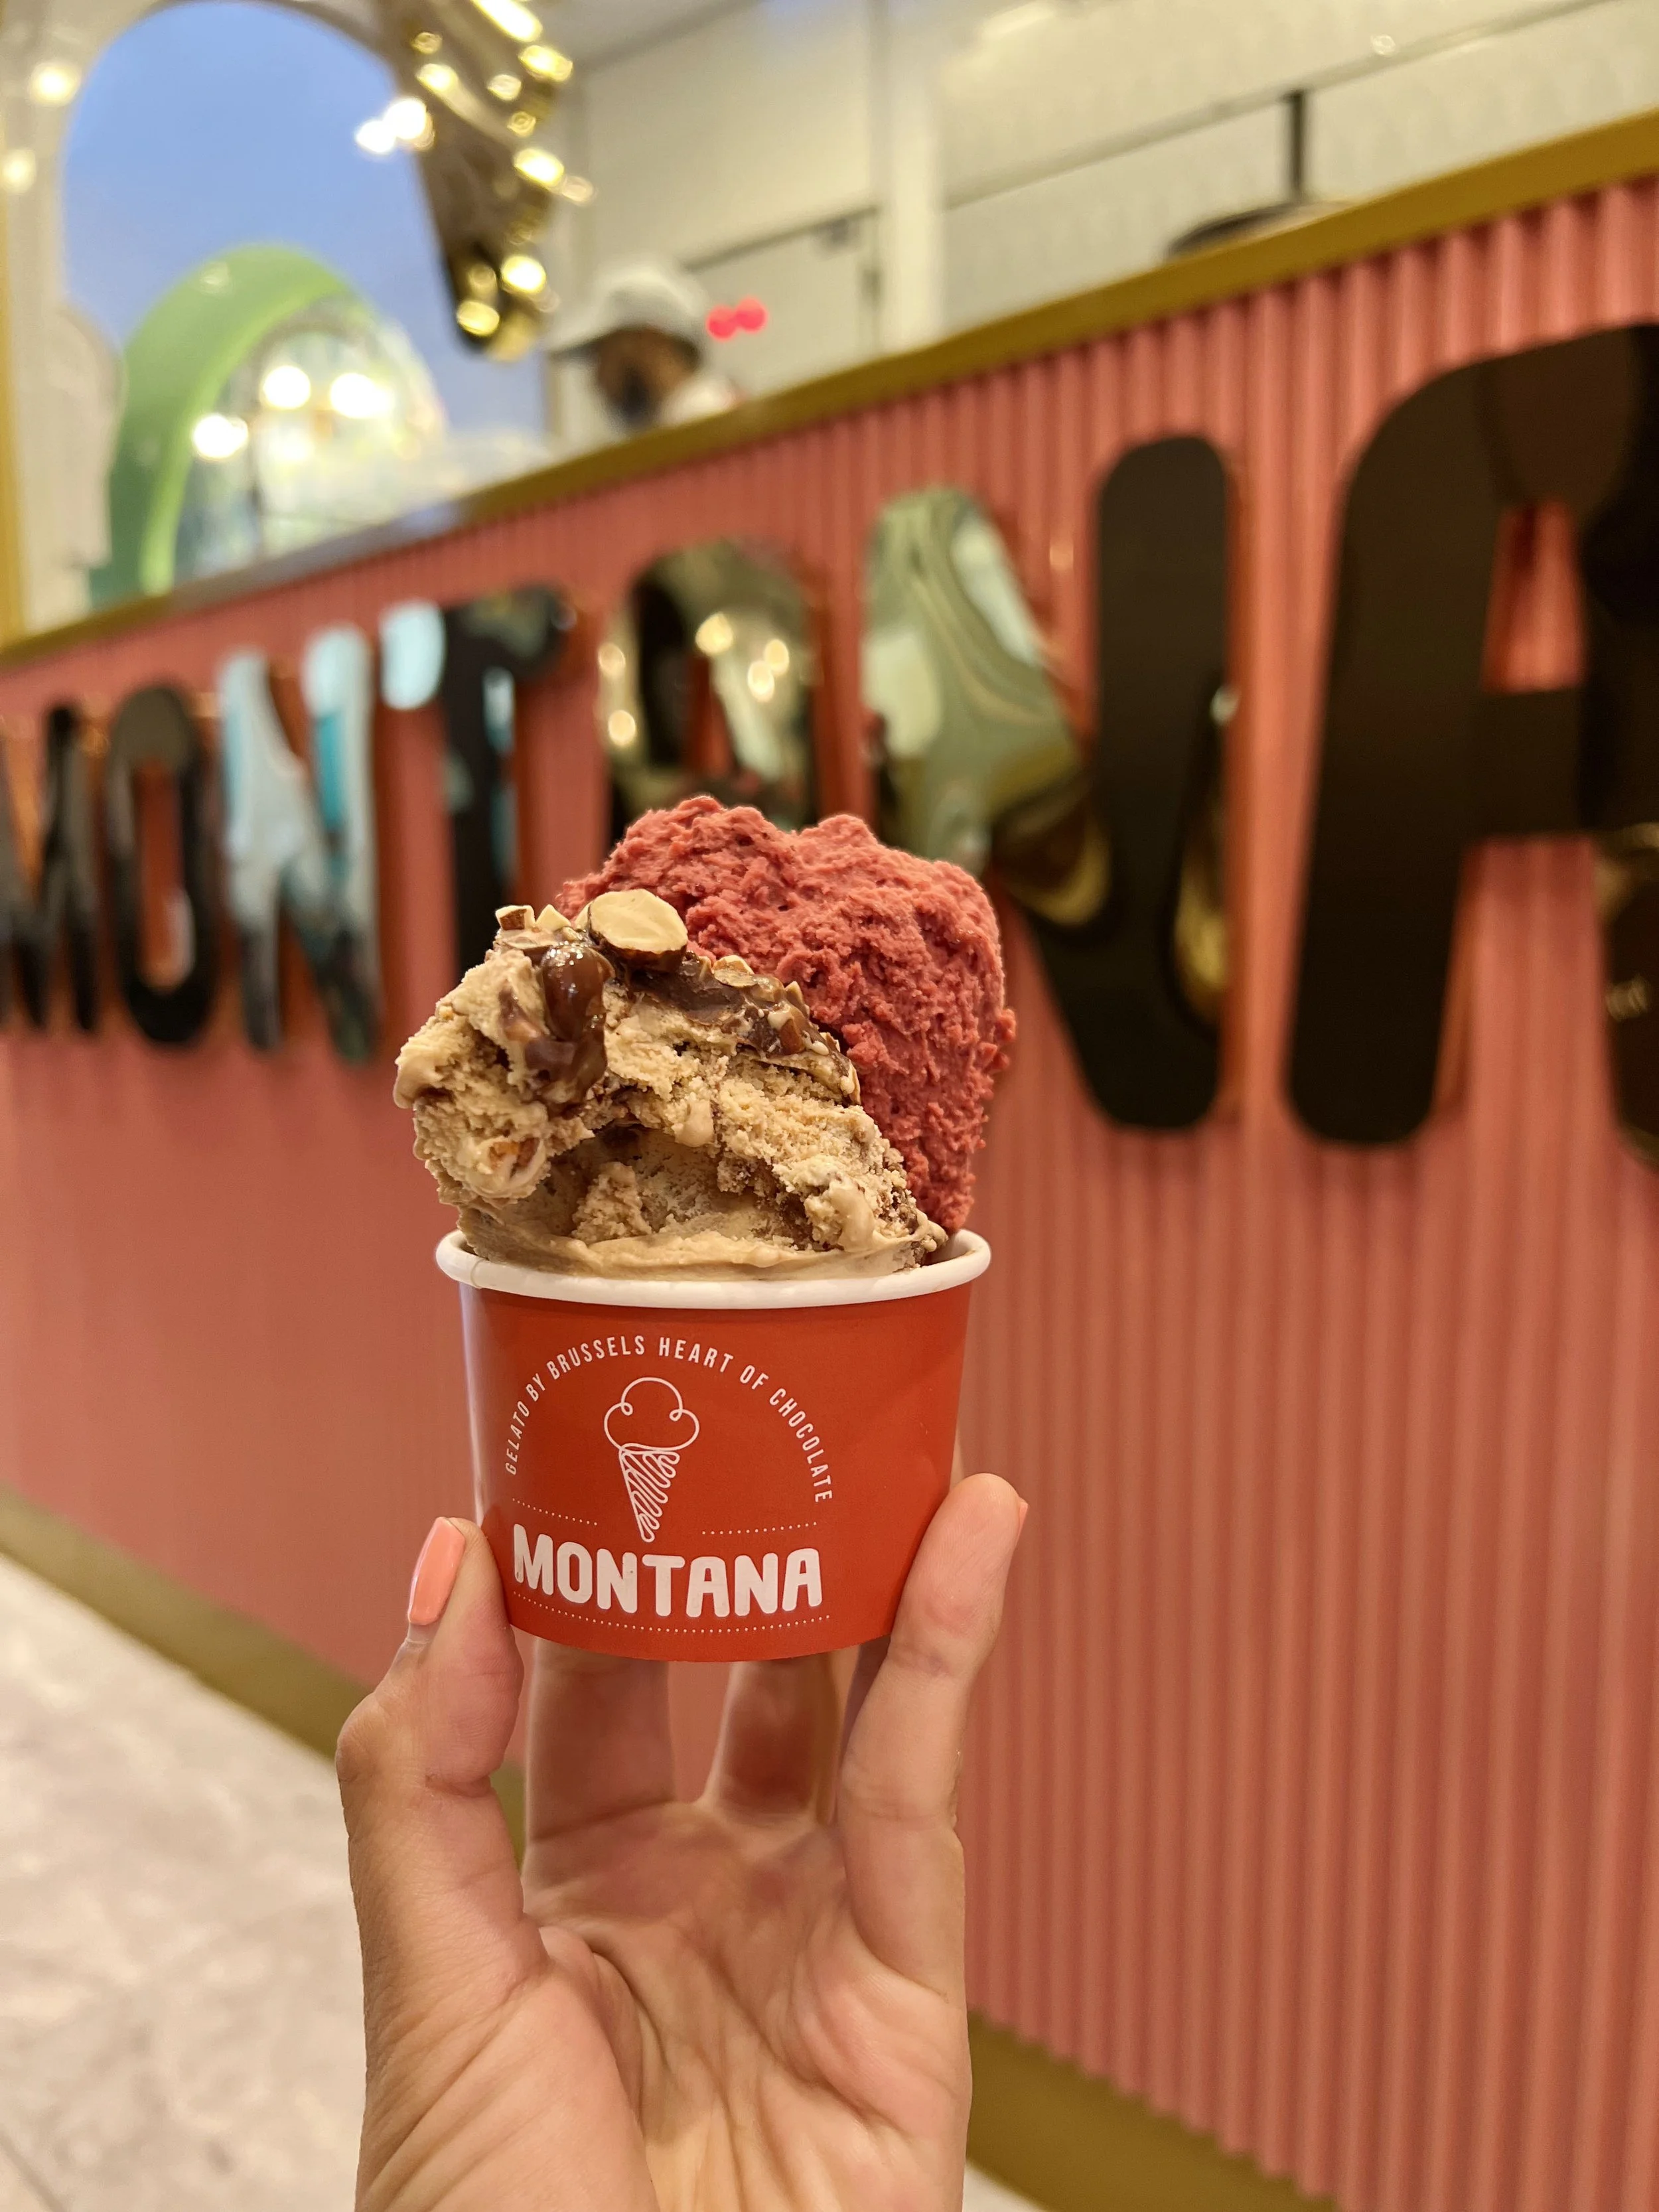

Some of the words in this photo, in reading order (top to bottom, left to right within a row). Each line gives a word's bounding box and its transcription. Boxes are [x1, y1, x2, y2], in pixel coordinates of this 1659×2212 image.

[505, 1400, 530, 1476] GELATO
[525, 1372, 546, 1402] BY
[546, 1335, 645, 1380] BRUSSELS
[658, 1337, 734, 1373] HEART
[739, 1364, 769, 1390] OF
[769, 1388, 833, 1503] CHOCOLATE
[513, 1523, 823, 1618] MONTANA
